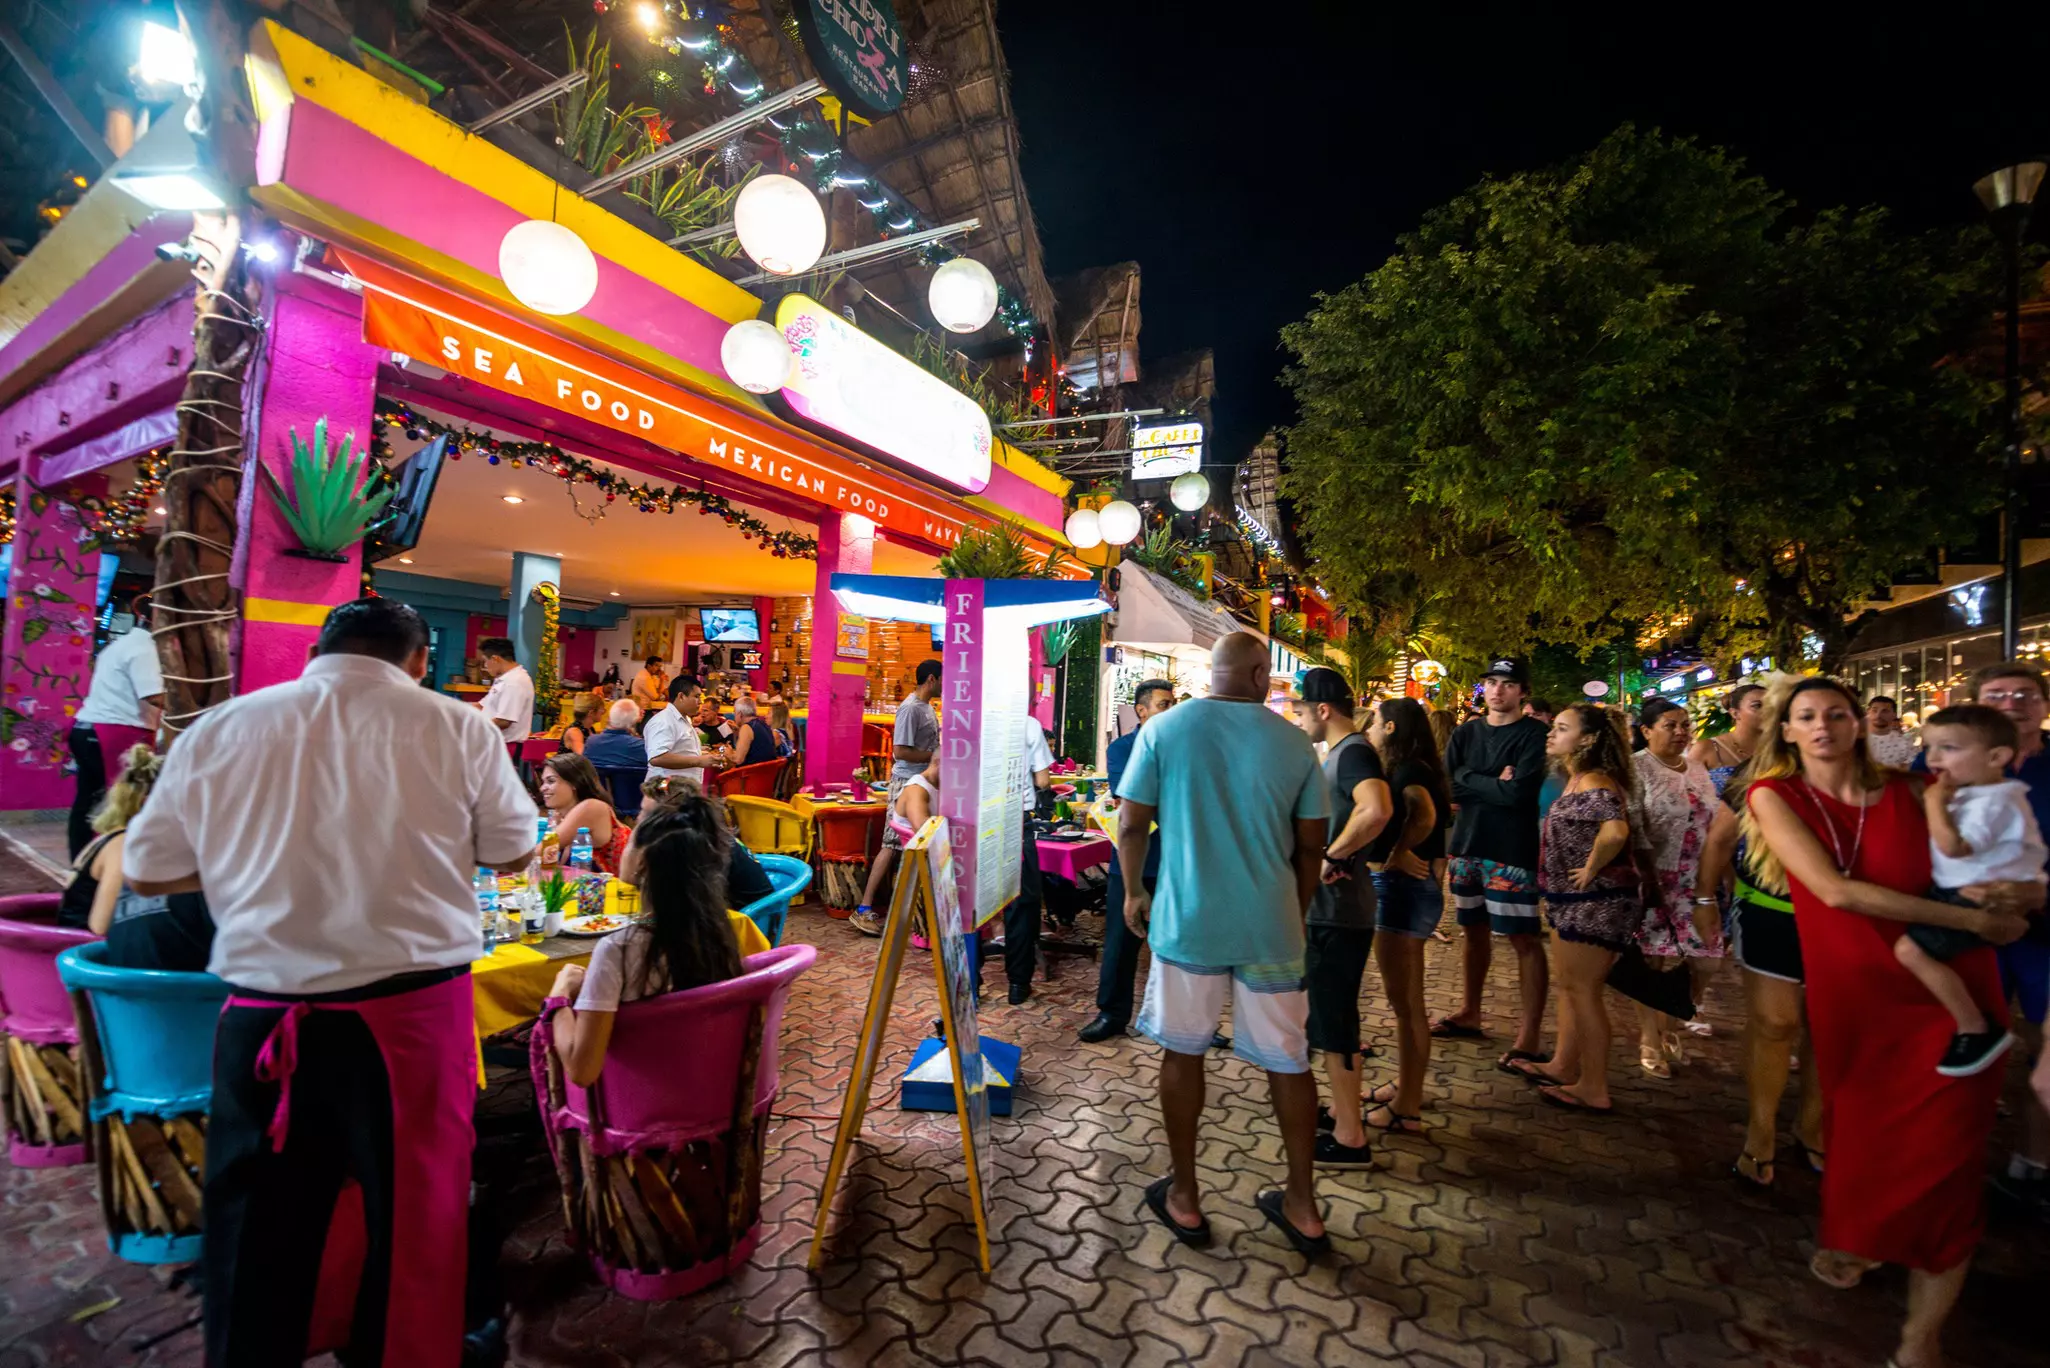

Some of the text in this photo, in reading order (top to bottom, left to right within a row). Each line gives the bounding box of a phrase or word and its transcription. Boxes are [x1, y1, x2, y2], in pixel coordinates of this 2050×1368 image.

[832, 44, 888, 104] RESTAURANTE
[852, 74, 869, 94] BAR
[442, 336, 965, 547] SEA FOOD MEXICAN FOOD MAYA
